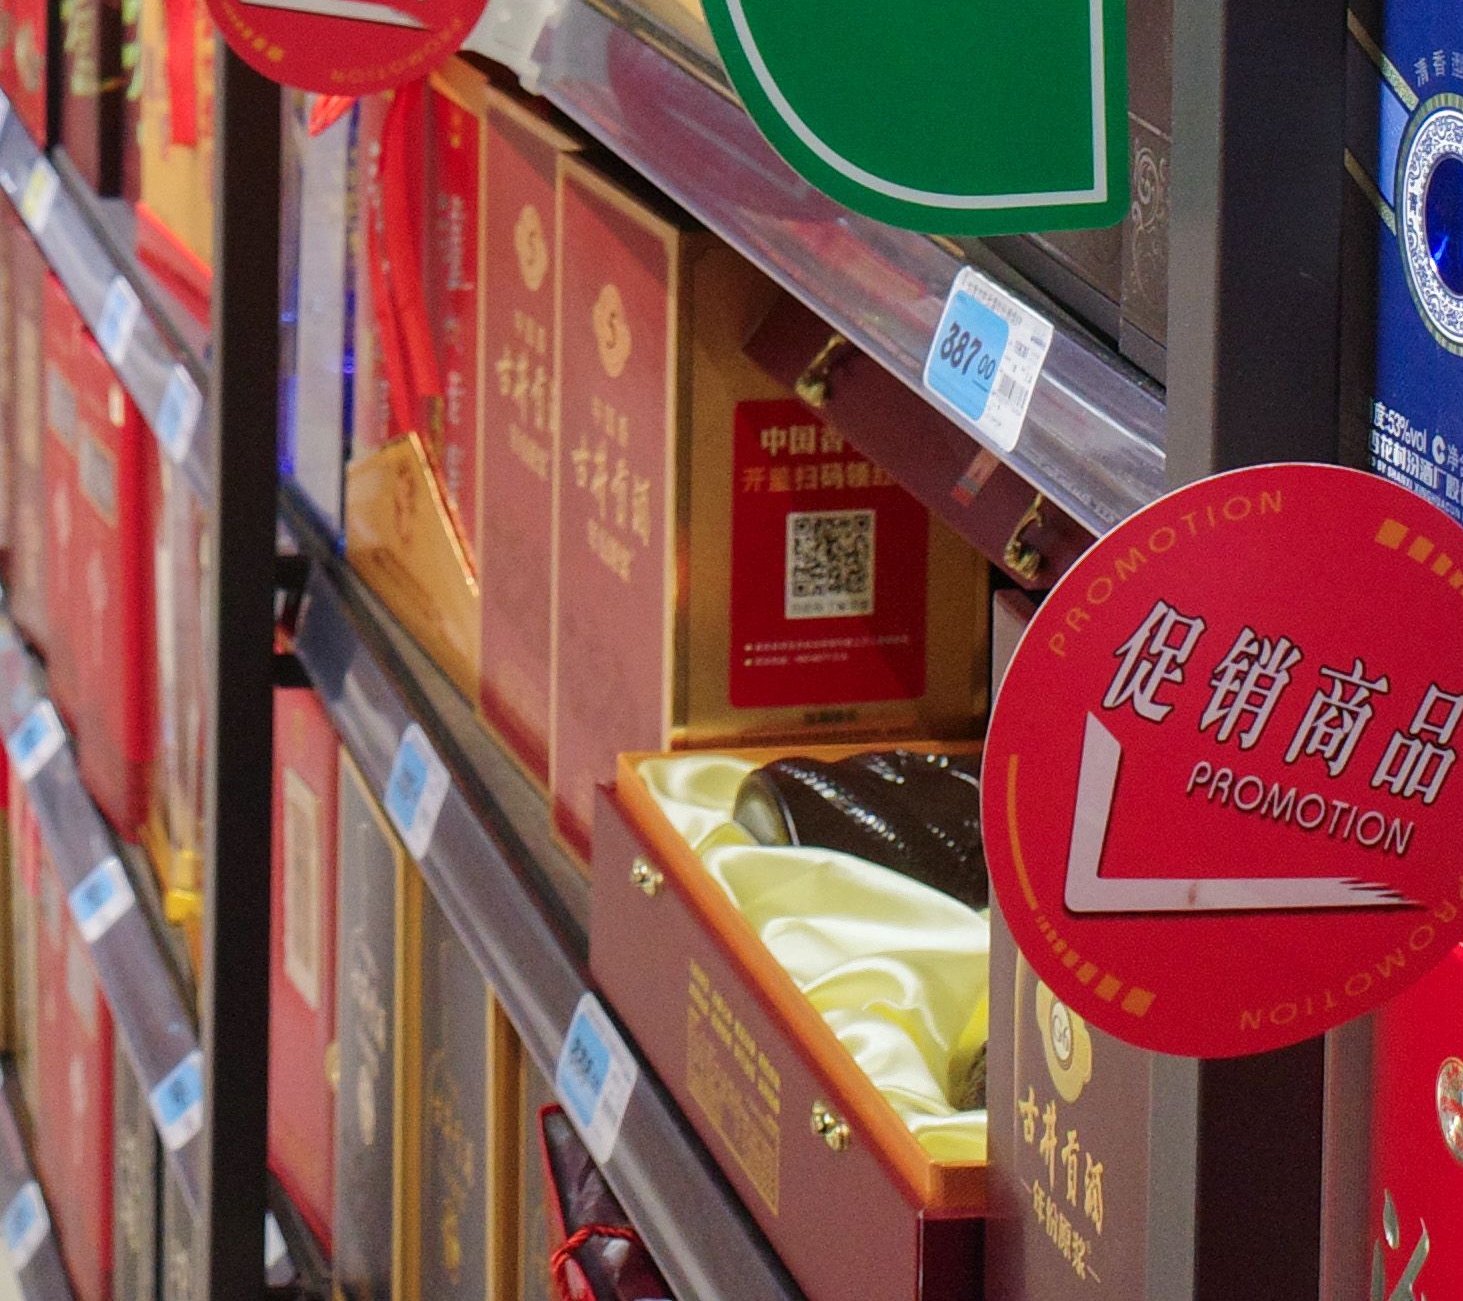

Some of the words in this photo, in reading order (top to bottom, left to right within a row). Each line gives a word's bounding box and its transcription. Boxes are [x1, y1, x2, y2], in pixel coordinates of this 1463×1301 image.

[939, 320, 983, 376] 387
[1048, 489, 1286, 659] PROMOTION
[1186, 759, 1417, 857] PROMOTION
[1017, 1084, 1104, 1236] 古井贡酒
